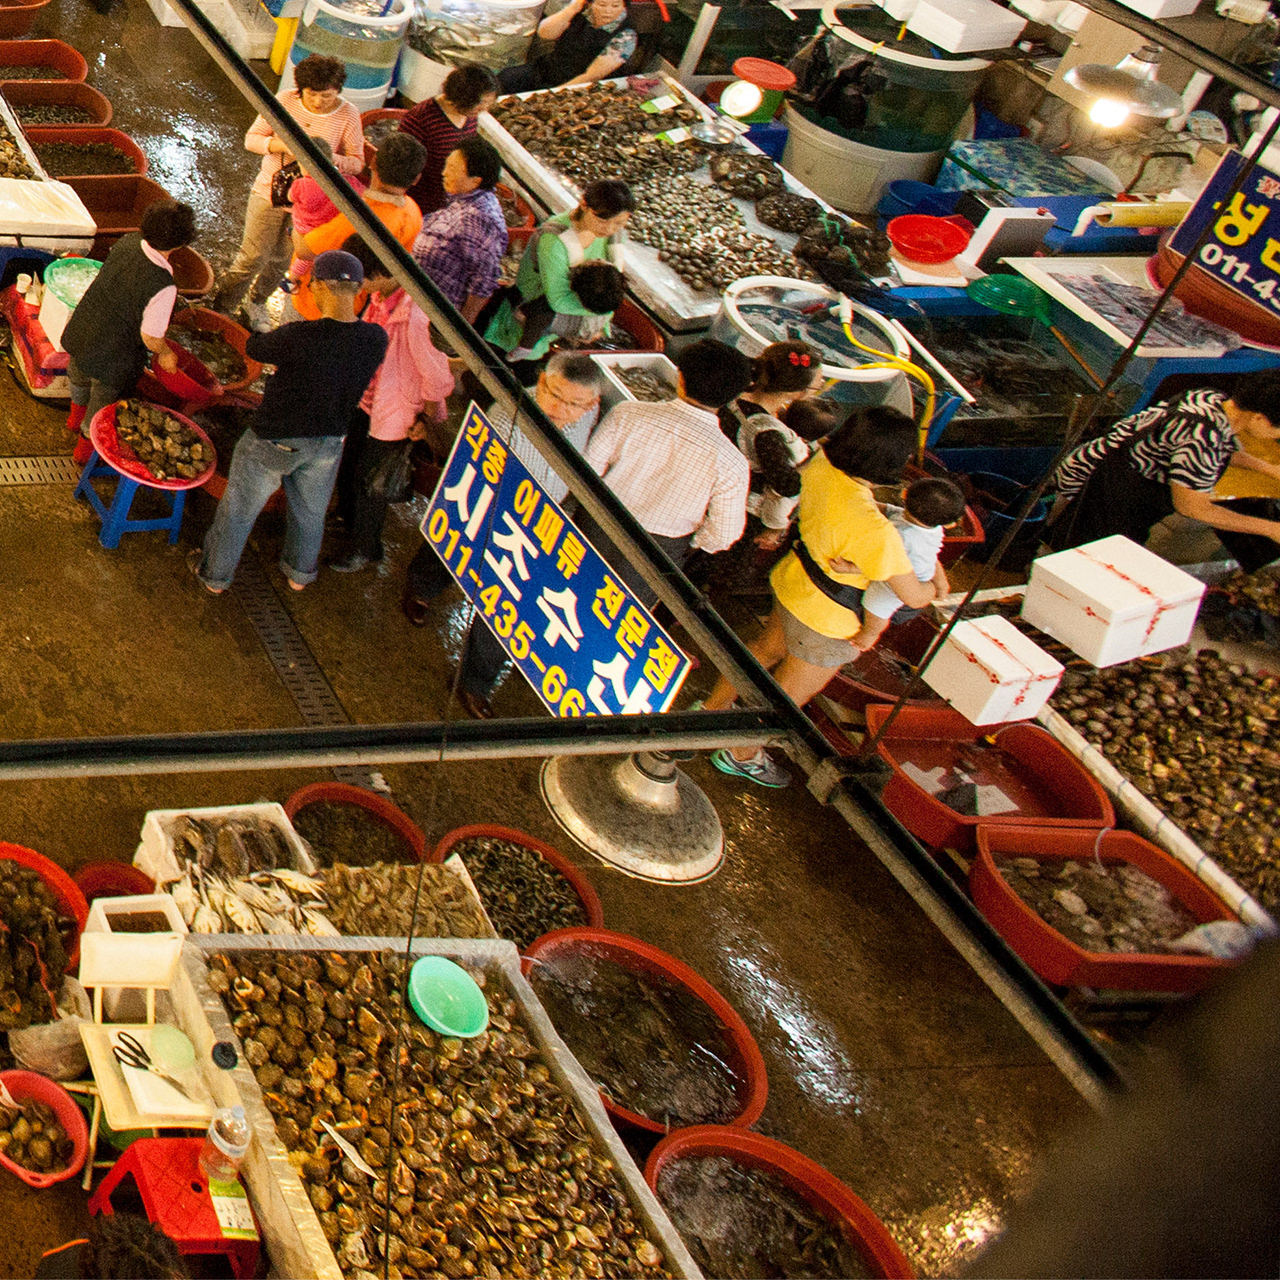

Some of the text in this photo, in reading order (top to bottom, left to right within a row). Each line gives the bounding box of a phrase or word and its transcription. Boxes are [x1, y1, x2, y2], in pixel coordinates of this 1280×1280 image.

[426, 506, 591, 718] 011-435-66
[443, 462, 654, 716] 시조수산
[463, 420, 688, 695] 각종 어패류 전문점
